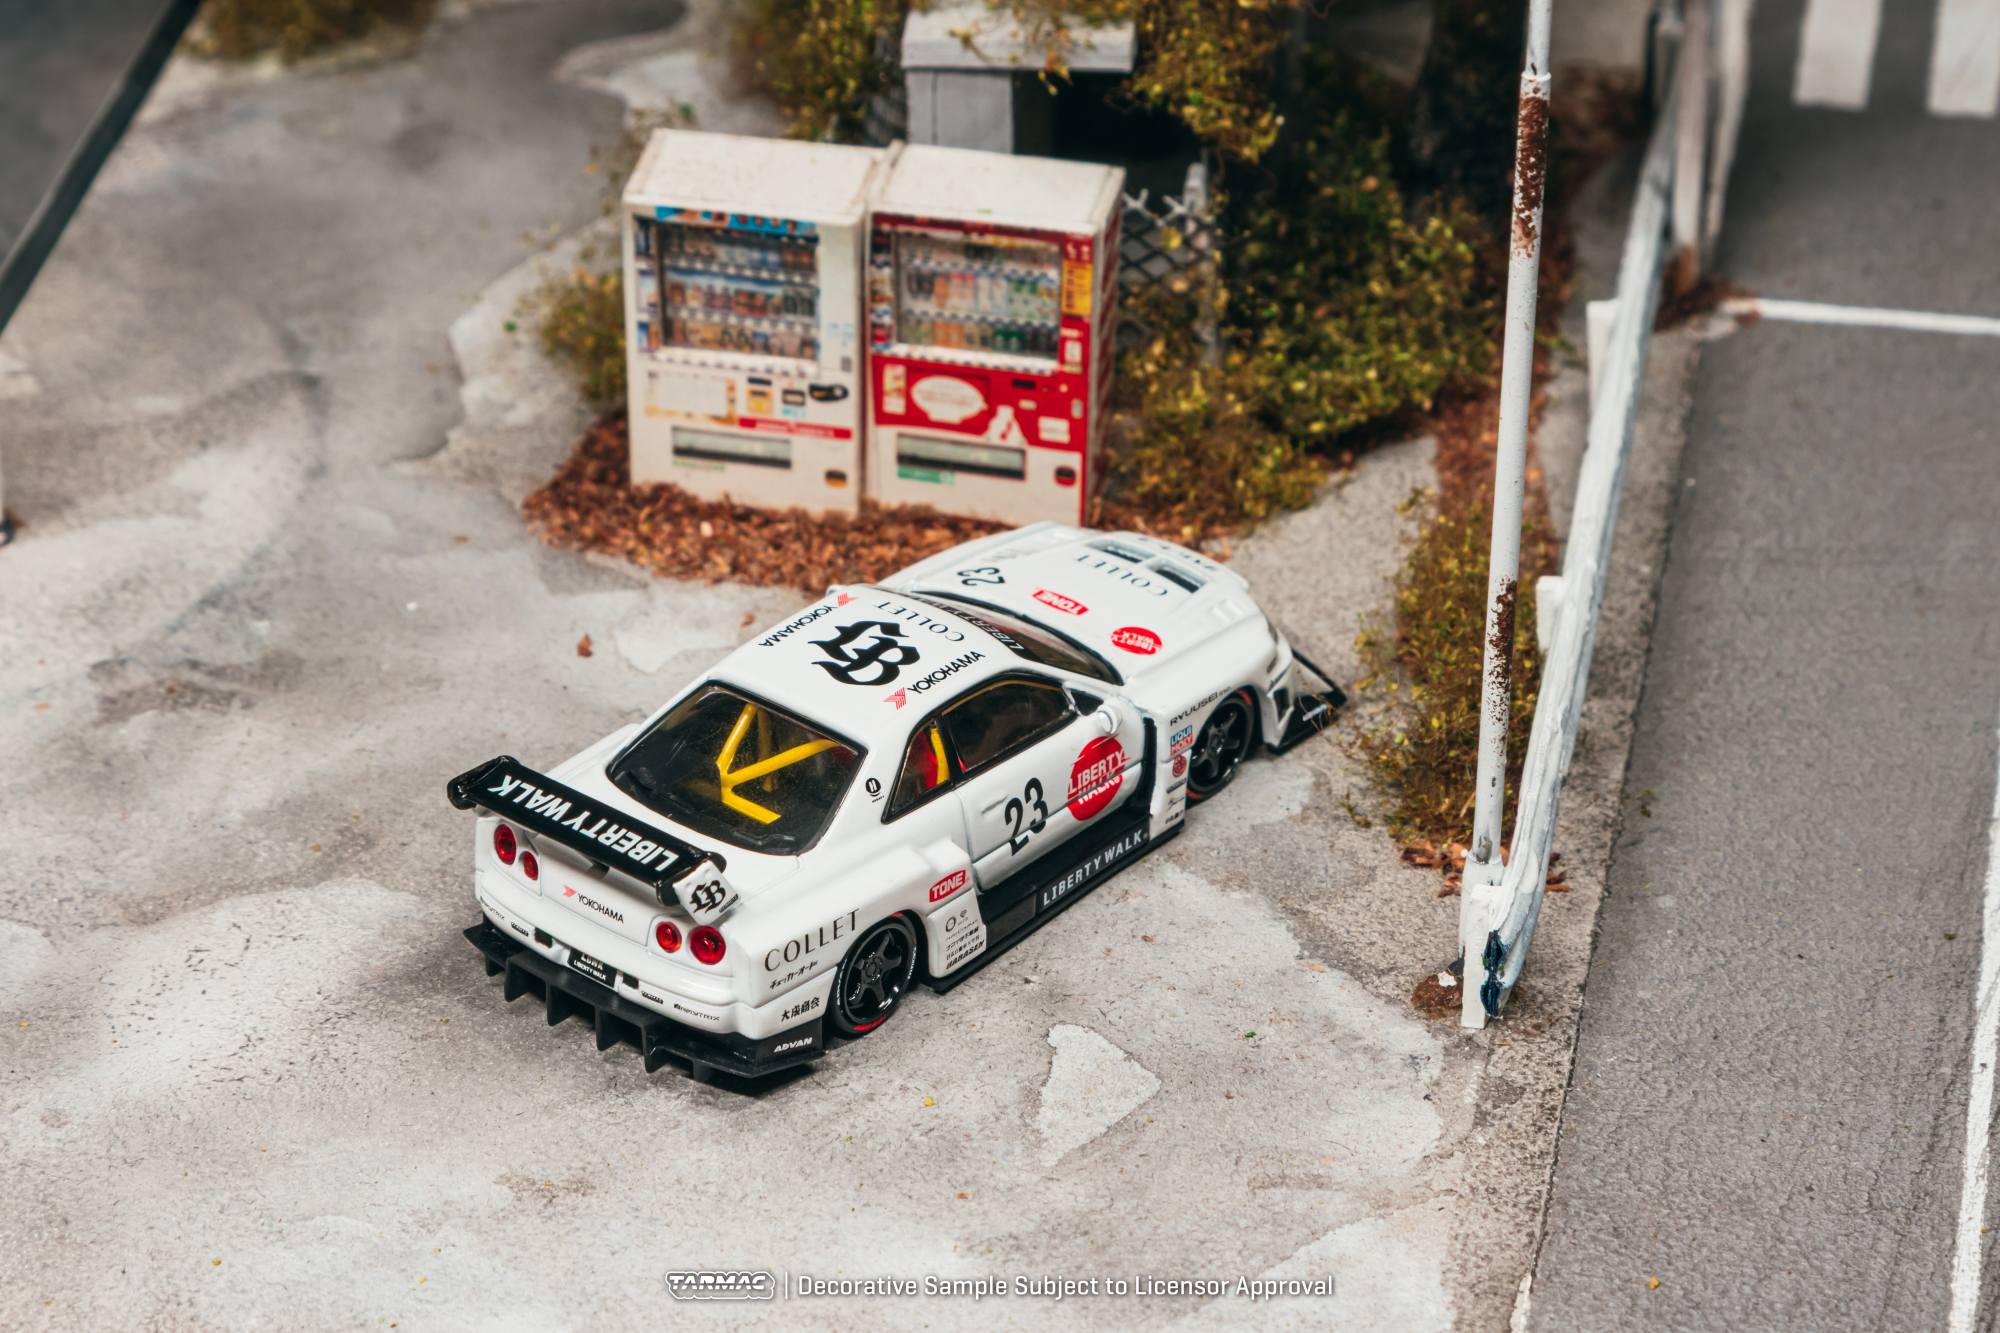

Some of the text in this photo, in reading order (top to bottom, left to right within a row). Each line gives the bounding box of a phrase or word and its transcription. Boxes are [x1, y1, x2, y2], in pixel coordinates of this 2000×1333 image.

[957, 566, 1006, 587] 23
[874, 601, 965, 642] COLLET
[1039, 591, 1084, 614] TONE
[758, 605, 838, 647] YOKOHAMA
[907, 651, 986, 694] YOKOHAMA
[1171, 725, 1193, 744] LIQUI
[1068, 750, 1127, 795] LIBERTY
[487, 775, 679, 873] LIBERTY WALK
[1004, 777, 1049, 856] 23
[931, 871, 964, 899] TONE
[1043, 856, 1101, 906] LIBERTY
[577, 892, 624, 924] YOKOHAMA
[764, 908, 860, 972] COLLET
[774, 1037, 813, 1052] ADVAN
